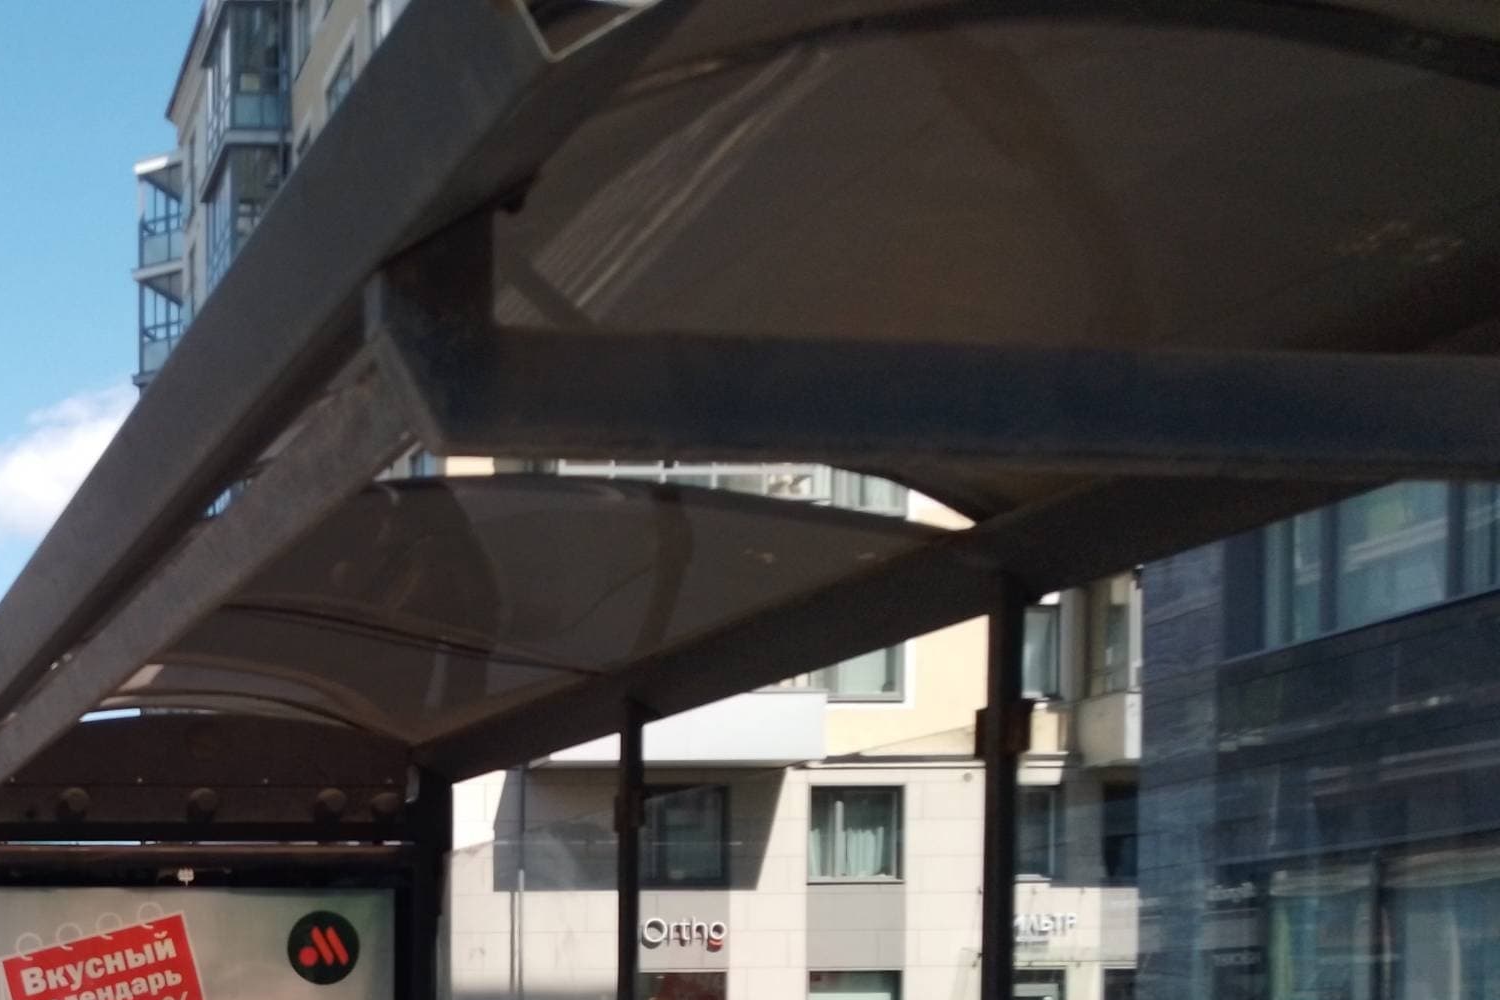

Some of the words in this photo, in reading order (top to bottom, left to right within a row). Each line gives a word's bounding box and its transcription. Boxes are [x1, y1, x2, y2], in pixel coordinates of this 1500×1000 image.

[643, 915, 726, 944] Ortho
[1013, 912, 1077, 932] ИЛЬТР
[19, 930, 178, 996] Вкусный
